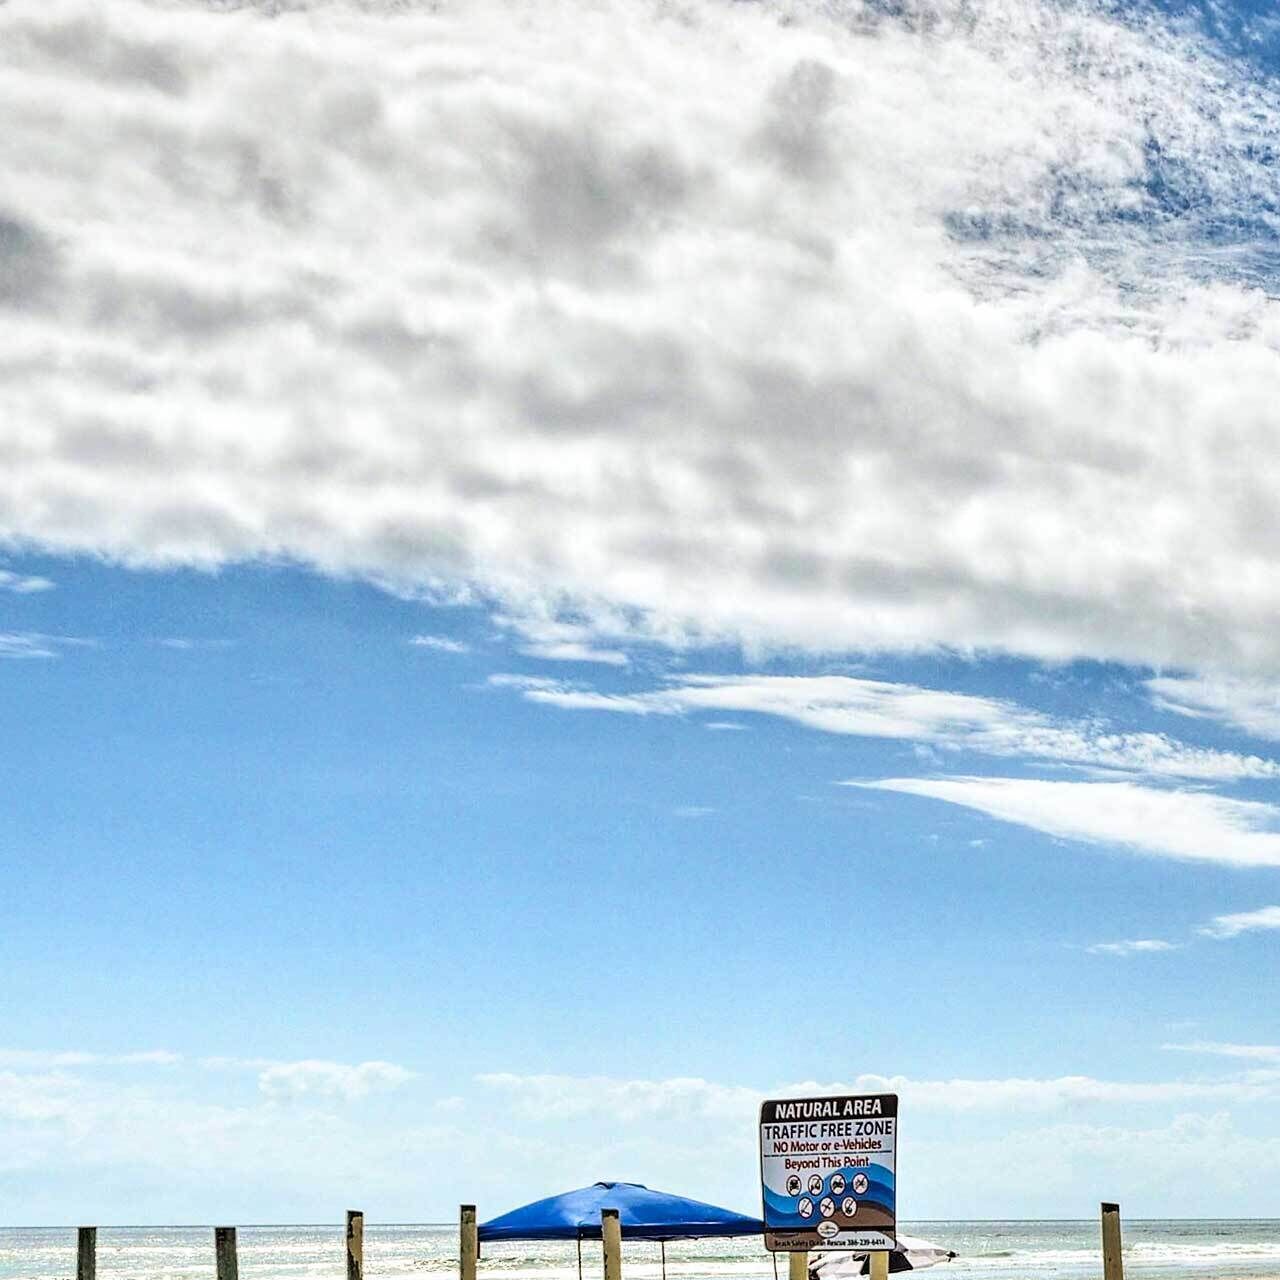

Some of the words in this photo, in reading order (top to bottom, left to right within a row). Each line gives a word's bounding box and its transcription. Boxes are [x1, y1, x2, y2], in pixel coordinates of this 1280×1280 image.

[775, 1101, 841, 1120] NATURAL
[843, 1099, 882, 1116] AREA
[764, 1123, 818, 1140] TRAFFIC
[820, 1122, 852, 1138] FREE
[855, 1120, 893, 1136] ZONE
[773, 1141, 788, 1153] NO
[790, 1140, 820, 1152] Motor
[821, 1141, 832, 1151] or
[834, 1138, 882, 1151] e-Vehicles
[785, 1157, 820, 1172] Beyond
[822, 1156, 842, 1168] This
[844, 1155, 870, 1167] Point
